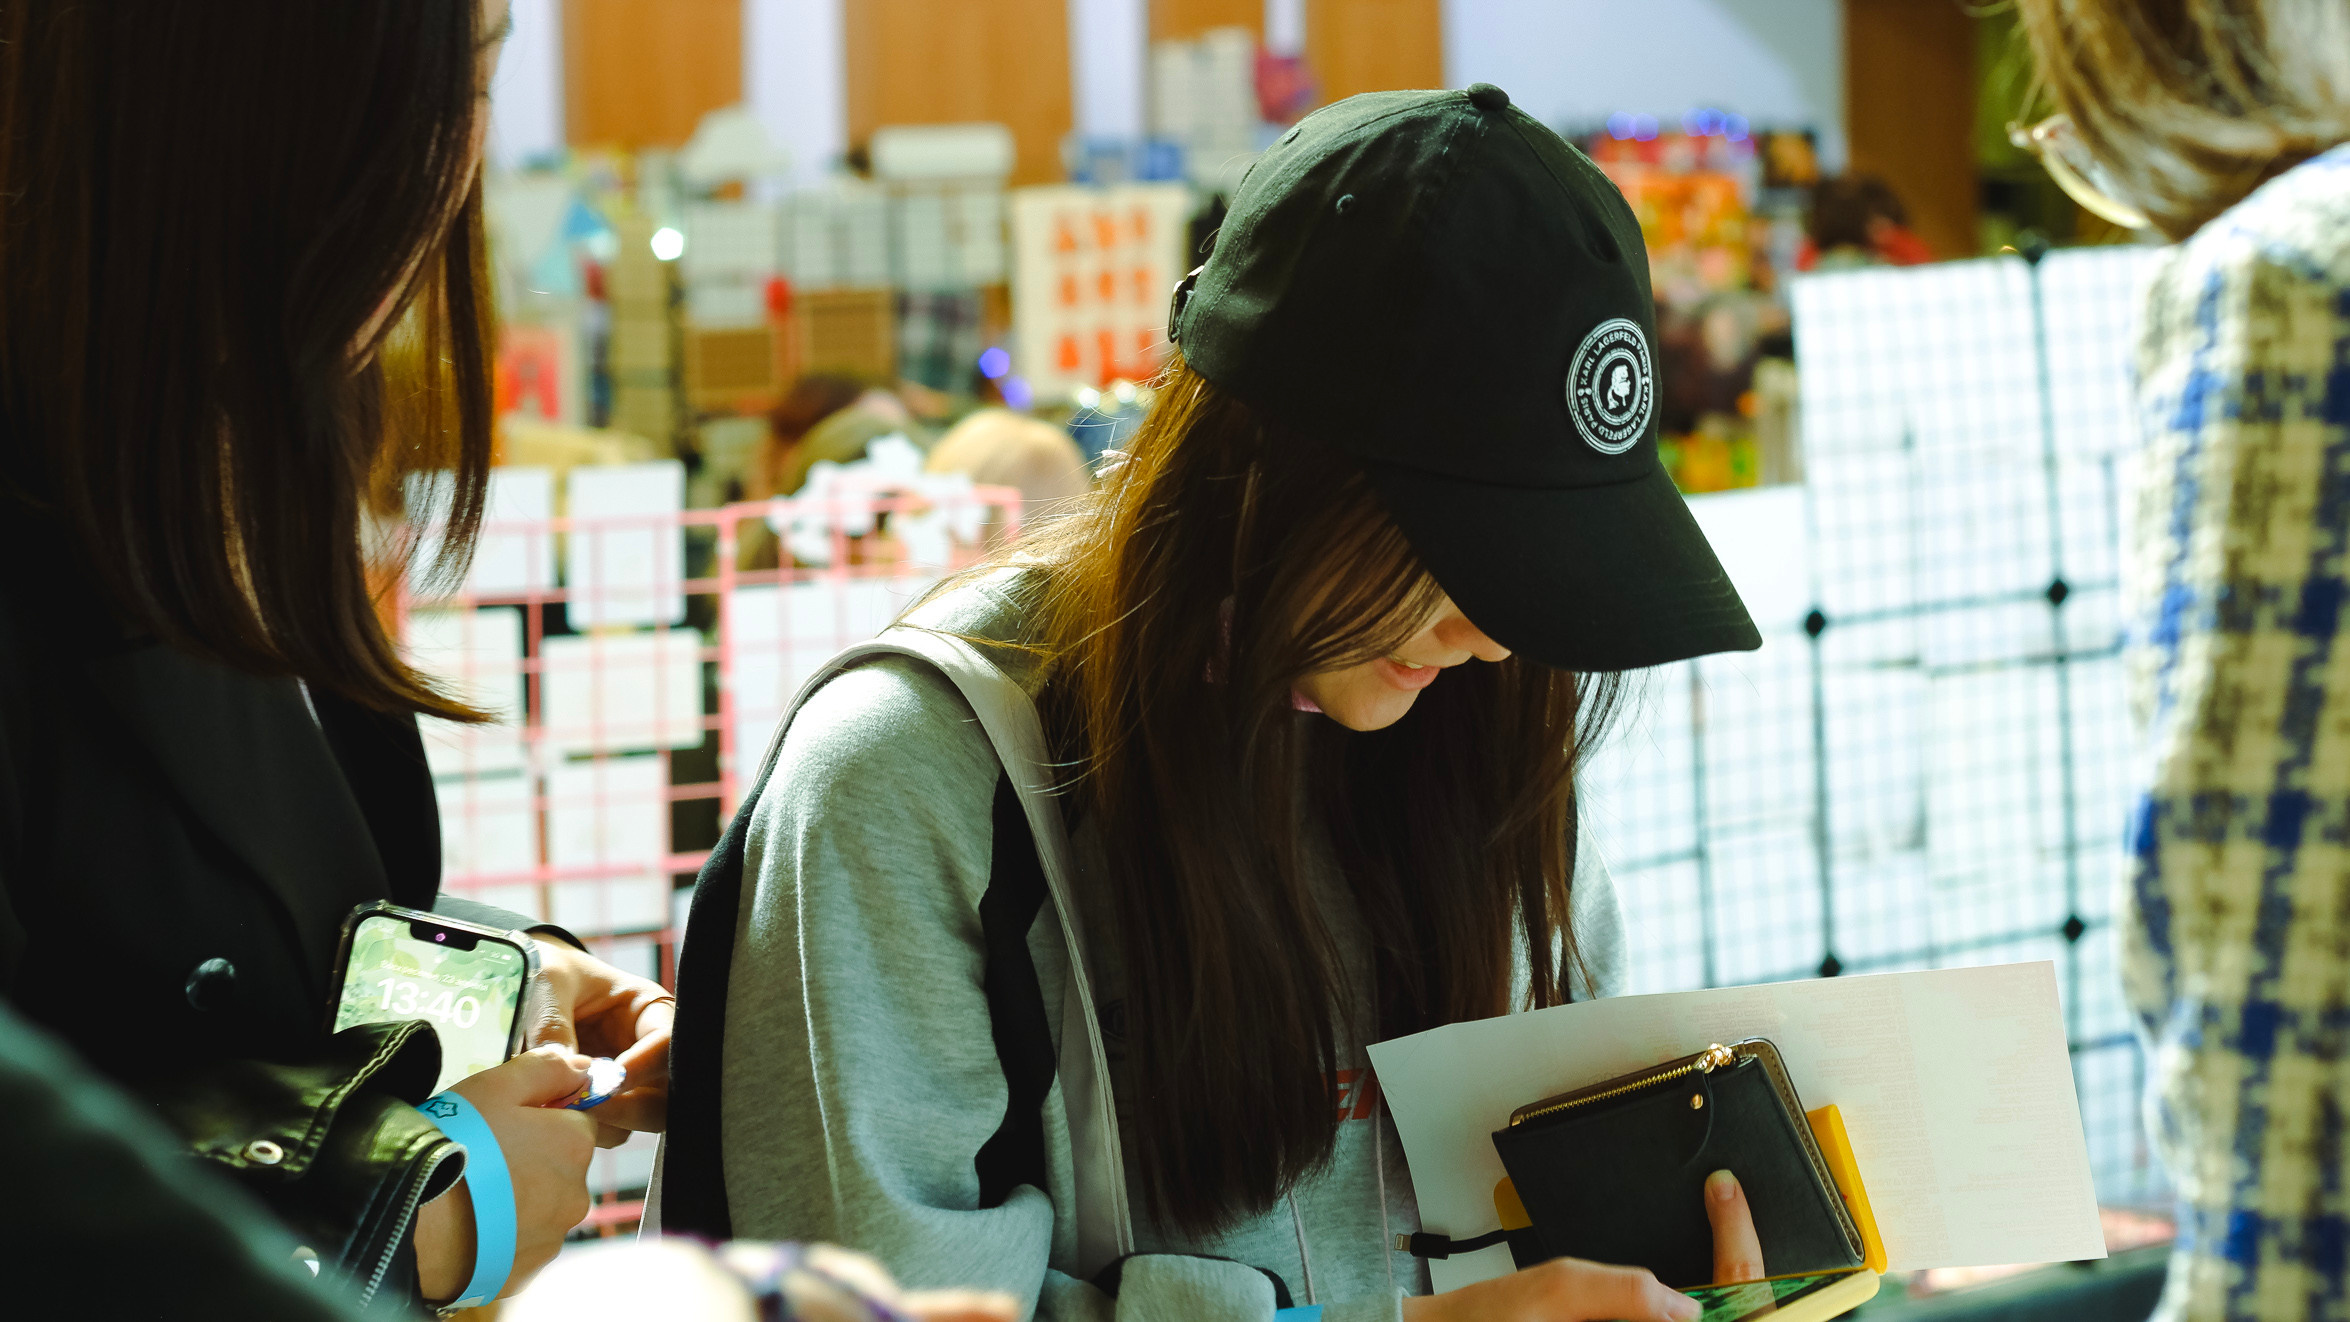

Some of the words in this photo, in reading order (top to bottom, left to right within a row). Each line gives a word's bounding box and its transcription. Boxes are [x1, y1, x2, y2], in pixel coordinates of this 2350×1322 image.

[1580, 356, 1596, 386] KARL
[1593, 331, 1637, 356] LAGERFELD
[1636, 342, 1648, 375] PARIS
[1580, 397, 1599, 430] PARIS
[1638, 385, 1649, 415] KARL
[1598, 416, 1641, 440] LAGERFELD
[376, 977, 481, 1029] 13:40
